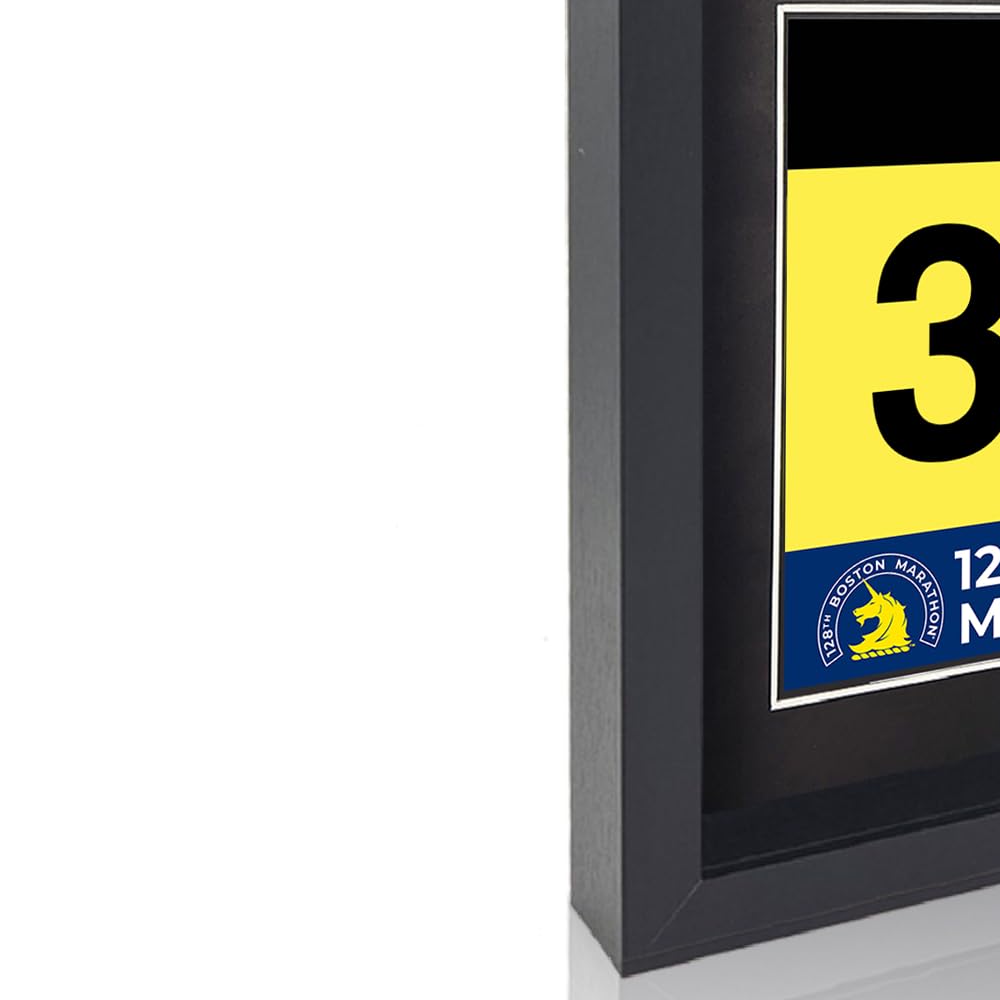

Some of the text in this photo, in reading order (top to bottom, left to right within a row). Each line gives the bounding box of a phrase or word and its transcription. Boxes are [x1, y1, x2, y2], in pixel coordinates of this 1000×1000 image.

[822, 559, 940, 658] 128TH BOSTON MARATHON
